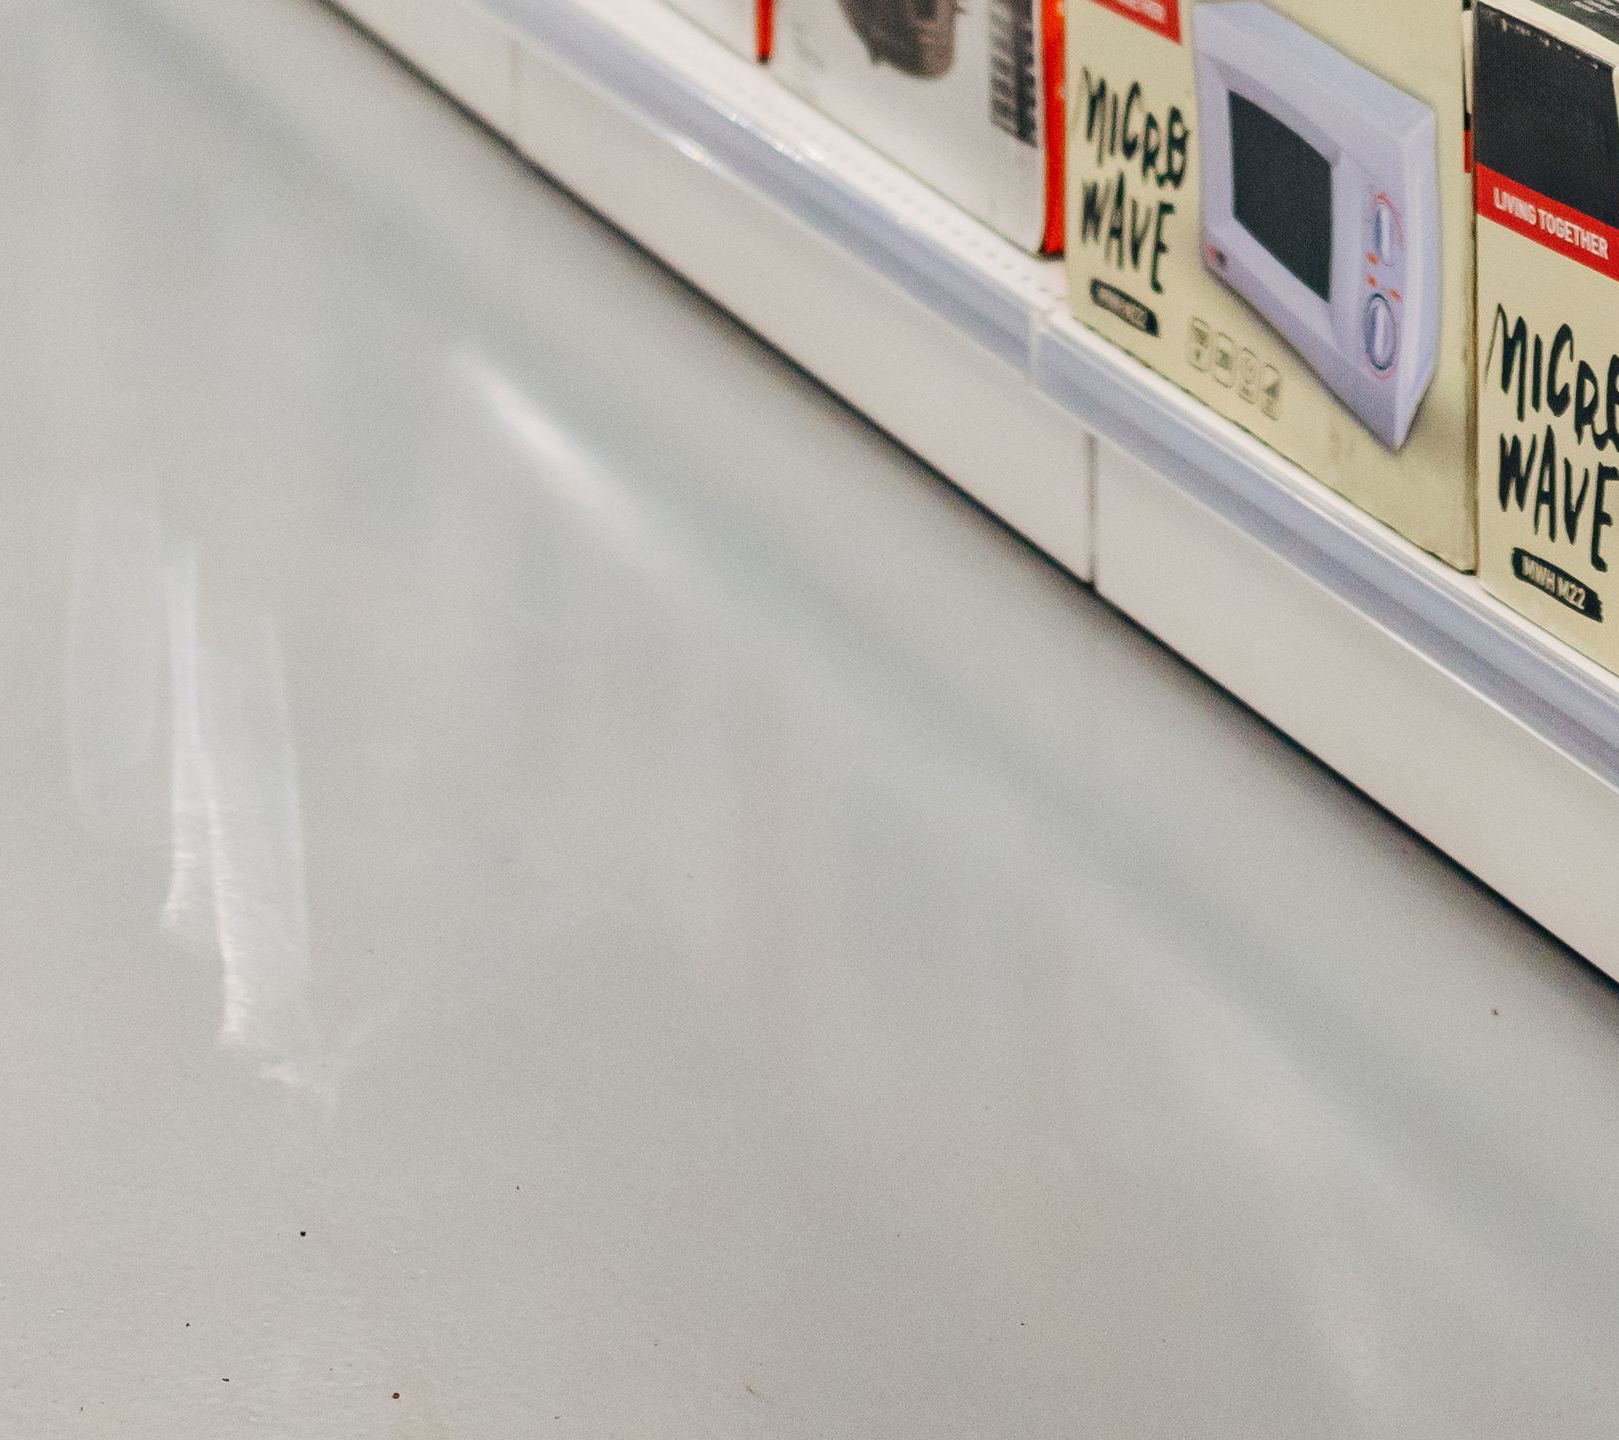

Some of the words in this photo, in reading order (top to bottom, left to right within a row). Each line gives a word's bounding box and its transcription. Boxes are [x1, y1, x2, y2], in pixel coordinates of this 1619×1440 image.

[1079, 170, 1176, 294] WAVE
[1492, 186, 1537, 226] LIVING
[1537, 207, 1610, 261] TOGETHER
[1520, 554, 1558, 594] MWH
